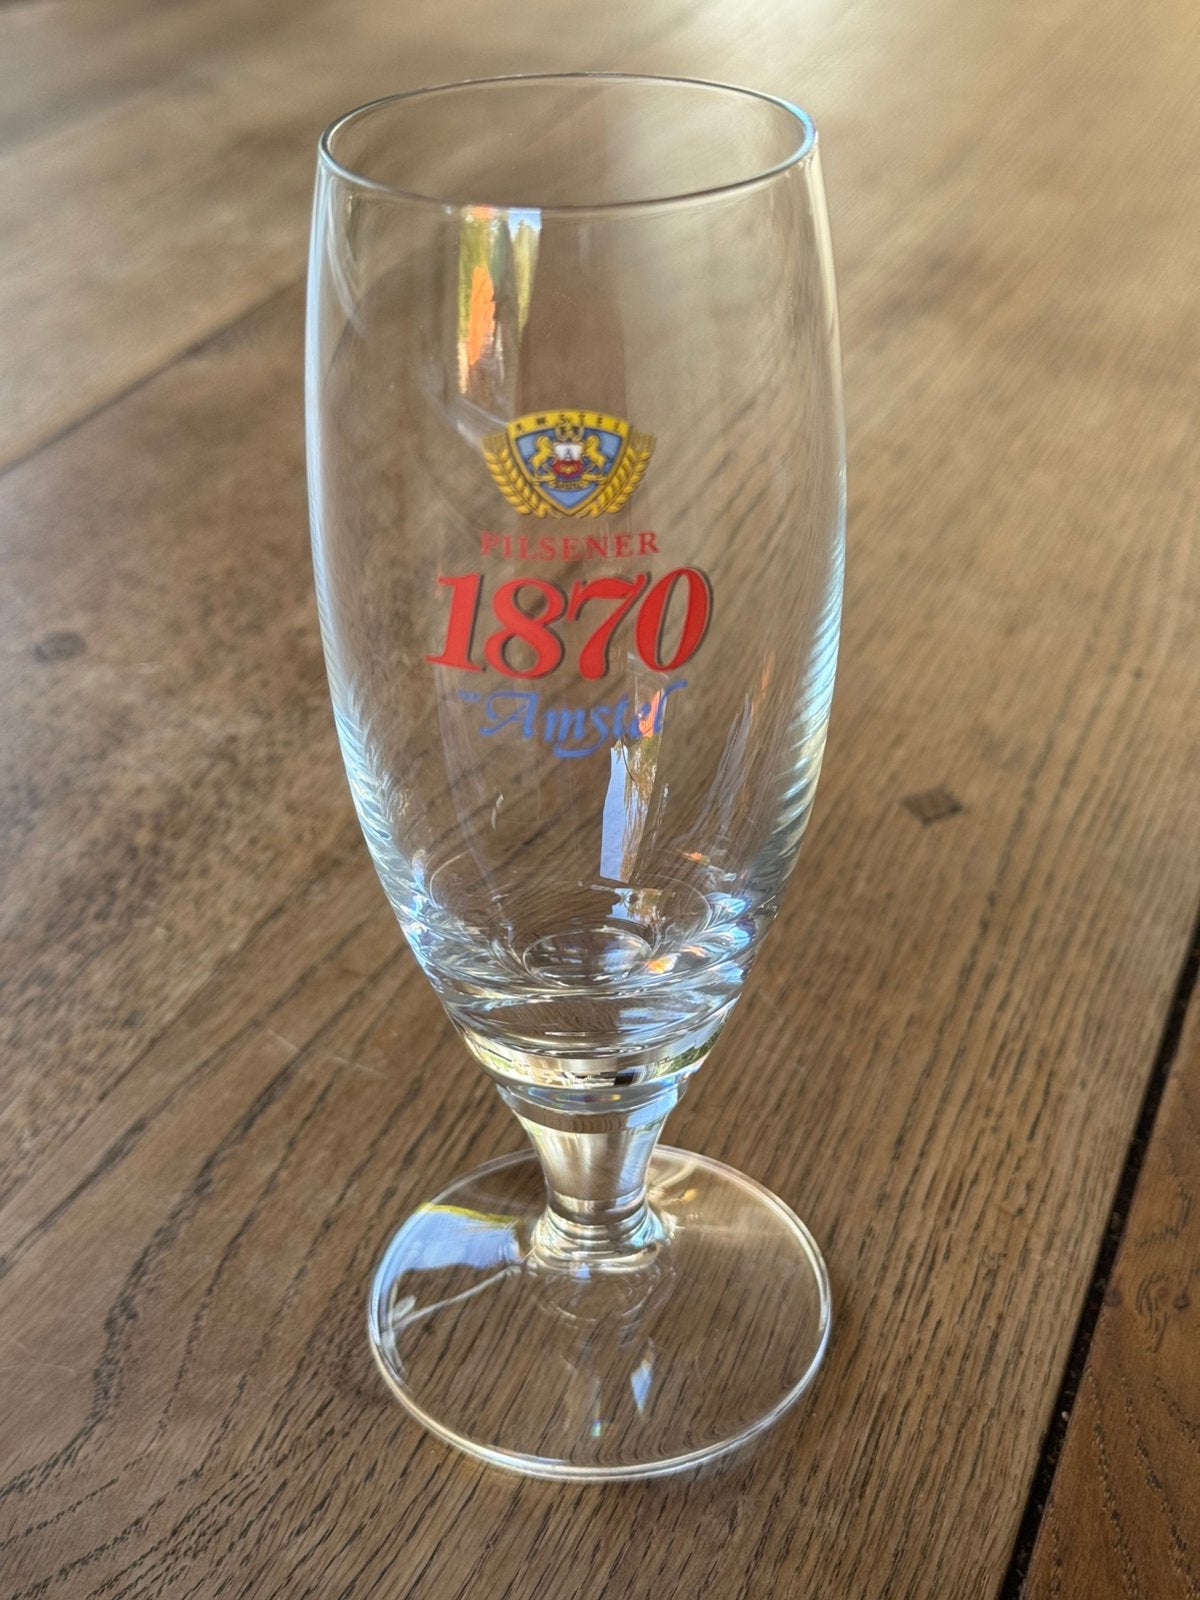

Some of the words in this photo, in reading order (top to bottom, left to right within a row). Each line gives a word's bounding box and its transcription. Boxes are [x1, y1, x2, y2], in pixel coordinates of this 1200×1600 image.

[479, 531, 660, 561] PILSENER
[425, 566, 713, 680] 1870
[479, 679, 688, 758] Amstel
